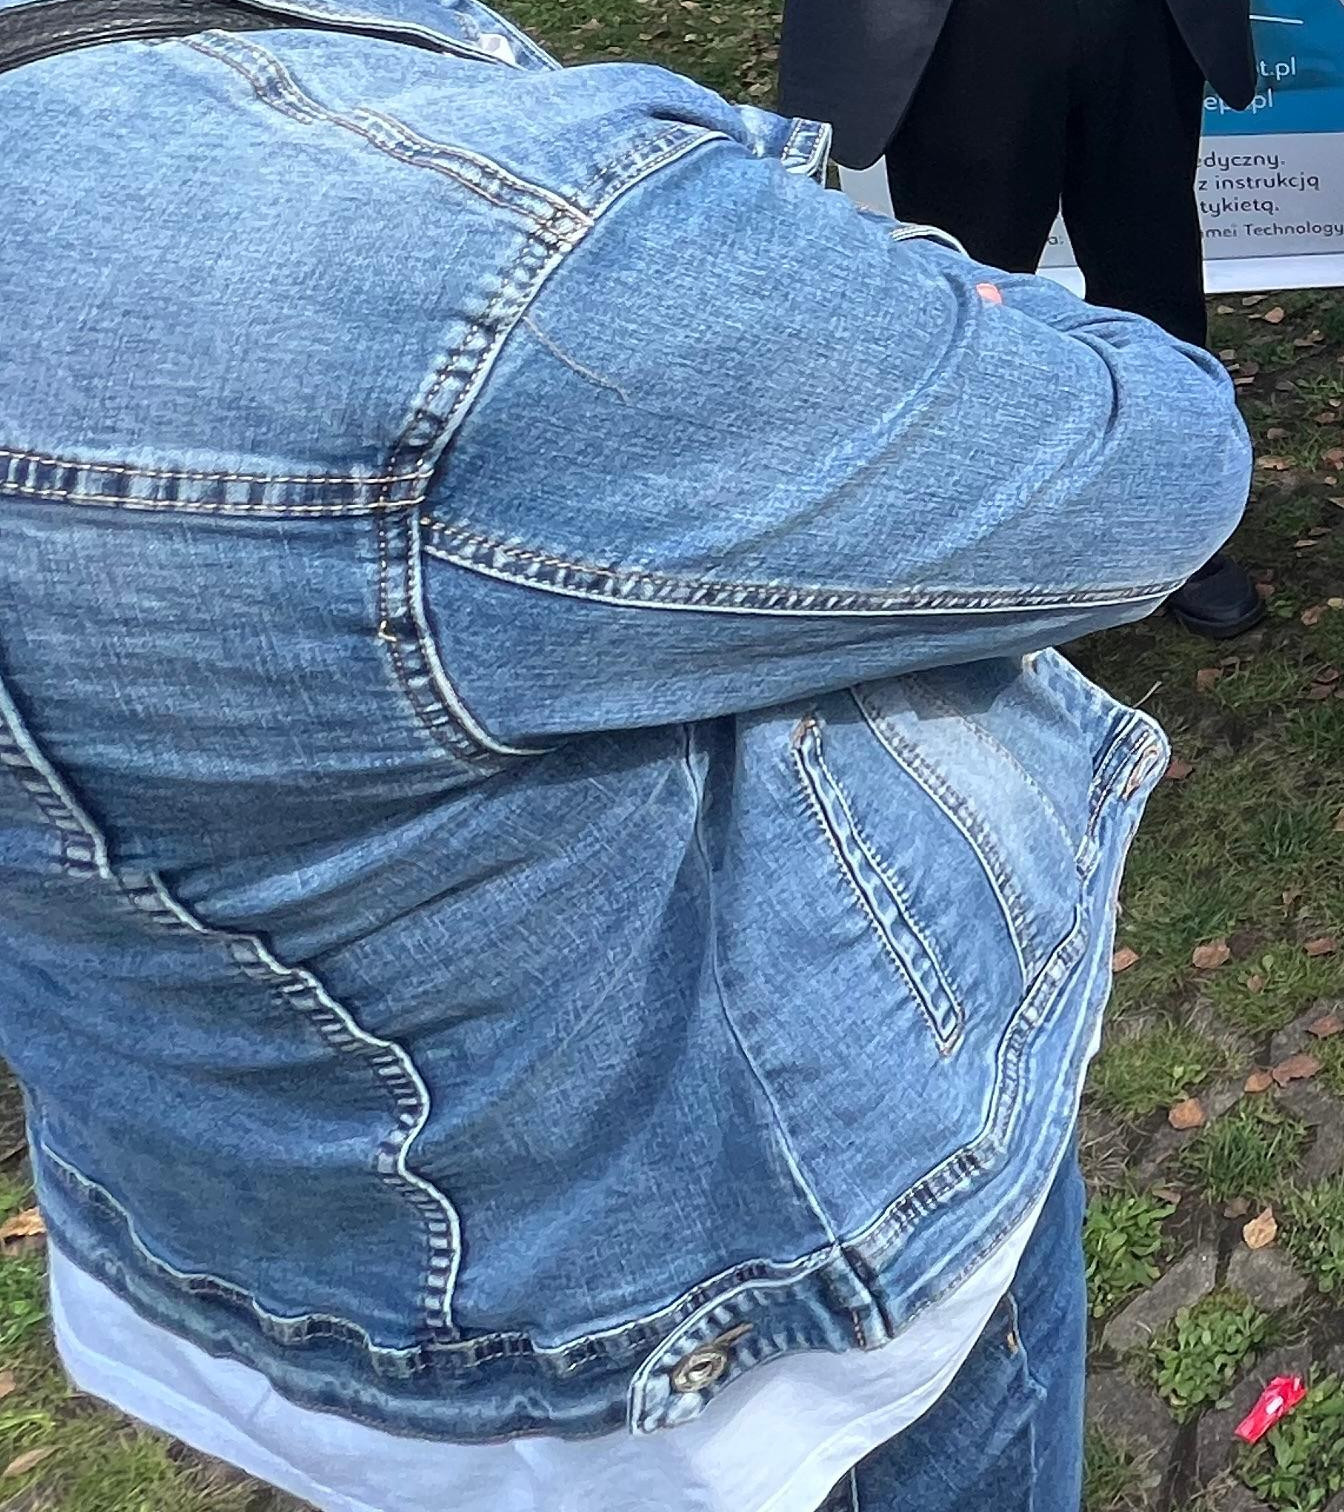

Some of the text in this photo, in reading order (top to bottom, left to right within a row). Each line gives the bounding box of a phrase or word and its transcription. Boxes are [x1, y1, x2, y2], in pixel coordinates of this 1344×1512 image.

[1215, 172, 1320, 191] instrukcją
[1200, 197, 1280, 218] tykietą.
[1243, 221, 1344, 237] Technology
